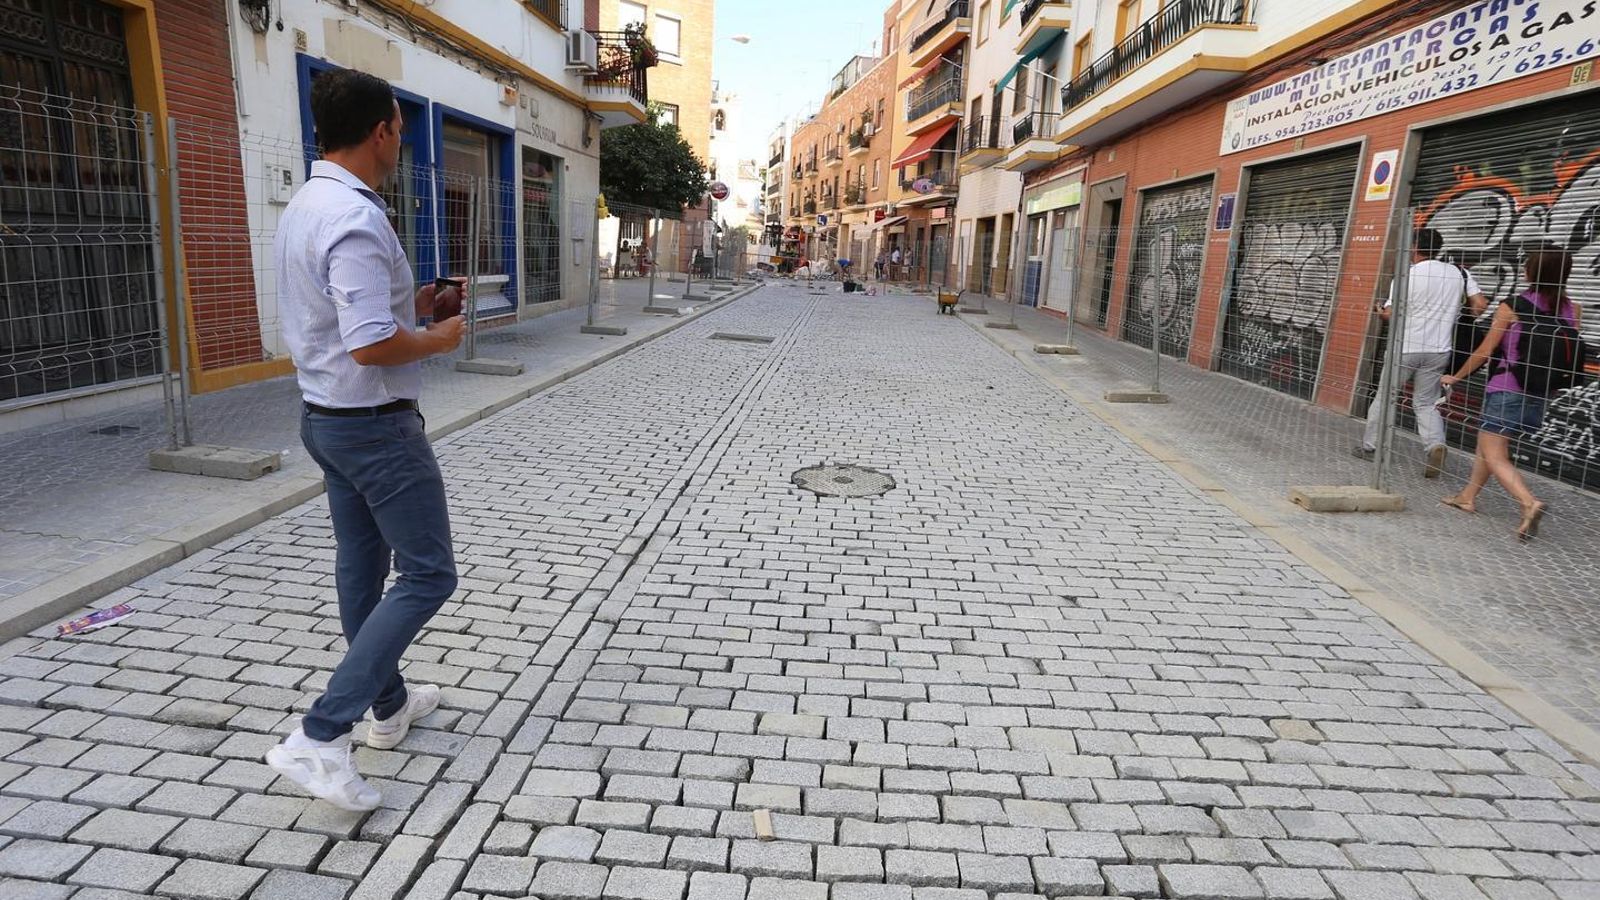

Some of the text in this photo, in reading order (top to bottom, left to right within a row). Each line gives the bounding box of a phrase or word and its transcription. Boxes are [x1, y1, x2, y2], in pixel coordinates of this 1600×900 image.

[1247, 1, 1597, 128] INSTALACION VEHICULOS A GAS
[1249, 0, 1533, 105] WWW.TALLERSANTACATA
[1275, 109, 1353, 139] 954.223.805
[1376, 74, 1478, 112] 615.911.432
[1515, 38, 1600, 74] 625.6
[1487, 42, 1541, 65] 1970
